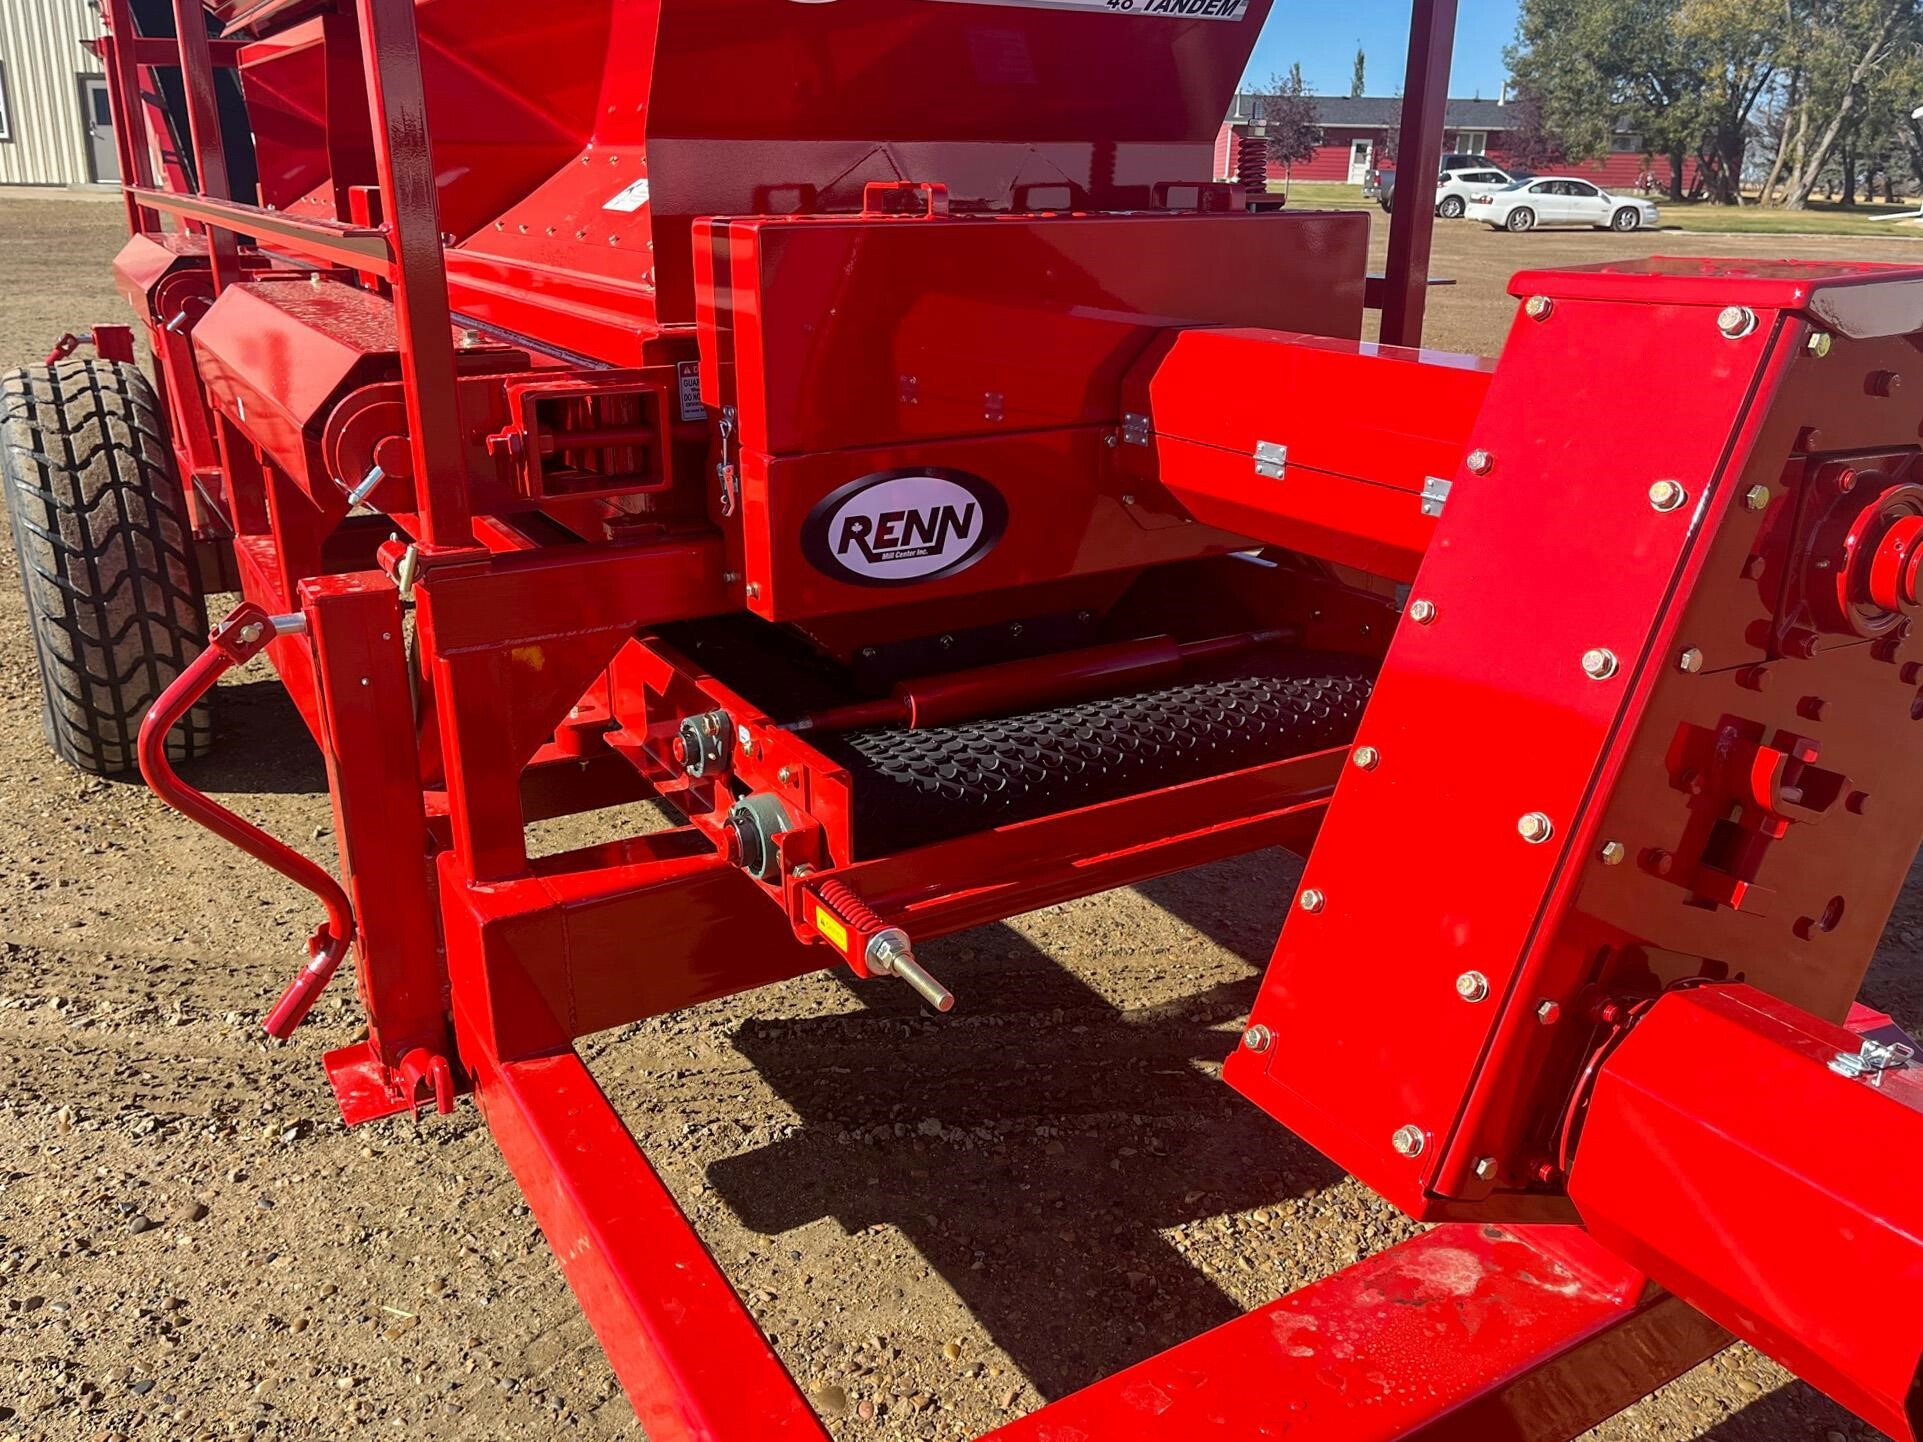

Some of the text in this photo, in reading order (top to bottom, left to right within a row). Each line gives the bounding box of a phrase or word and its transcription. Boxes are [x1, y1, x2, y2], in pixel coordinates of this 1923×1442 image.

[683, 378, 699, 387] GUA
[837, 502, 976, 563] RENN
[882, 551, 895, 560] Mill
[895, 549, 916, 558] Center
